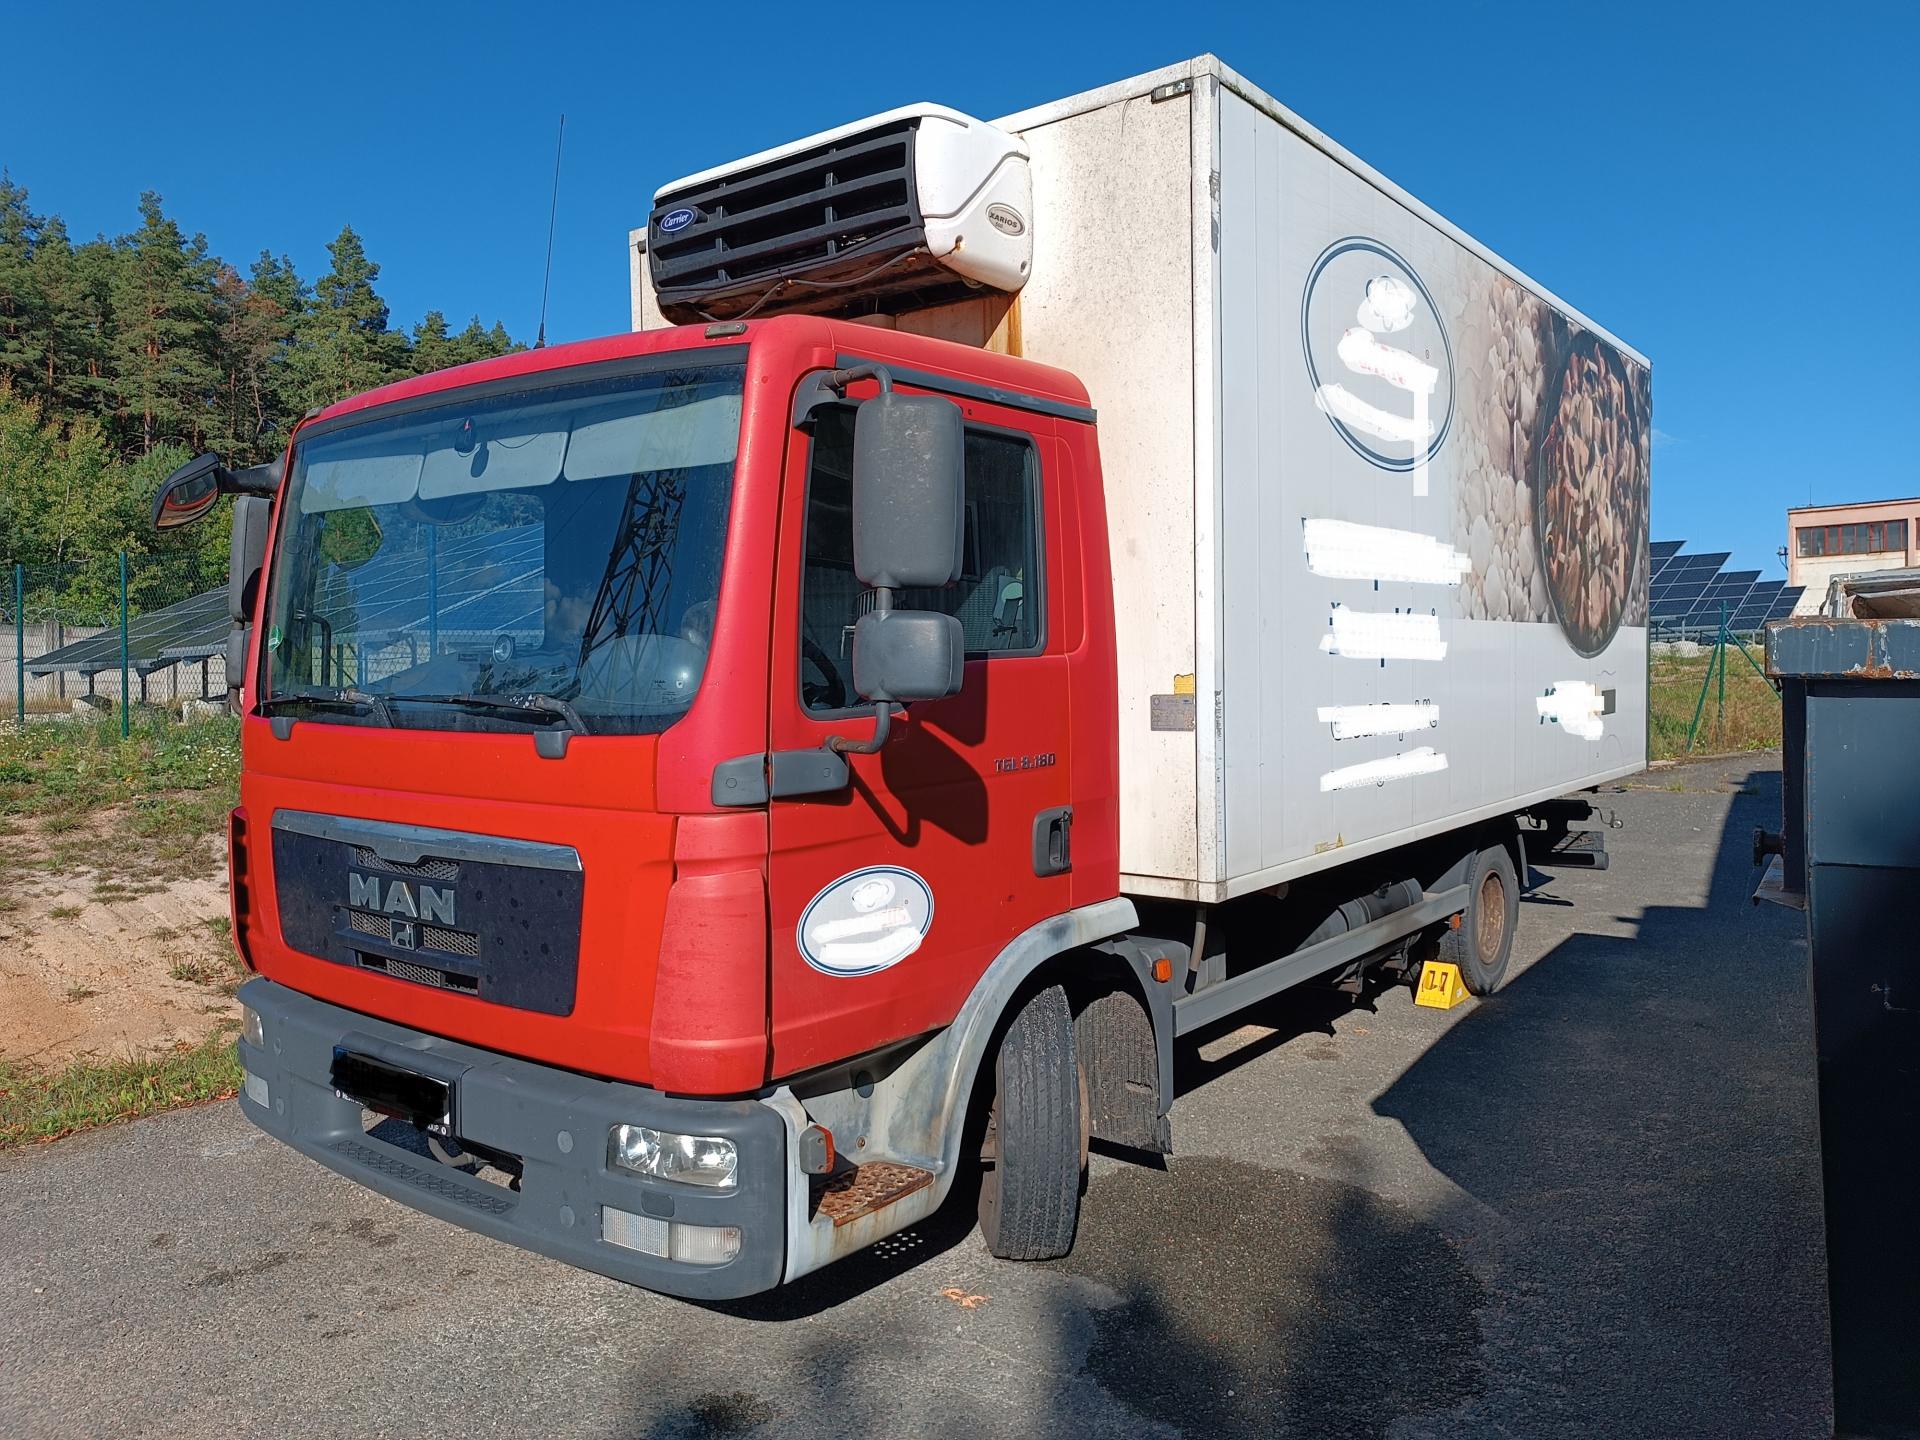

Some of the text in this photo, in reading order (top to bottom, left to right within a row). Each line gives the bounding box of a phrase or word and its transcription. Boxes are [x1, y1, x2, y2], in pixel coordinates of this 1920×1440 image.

[664, 214, 689, 227] Carrier
[989, 212, 1018, 228] XARIOS
[994, 753, 1055, 772] TGL 8.180
[349, 872, 456, 926] MAN
